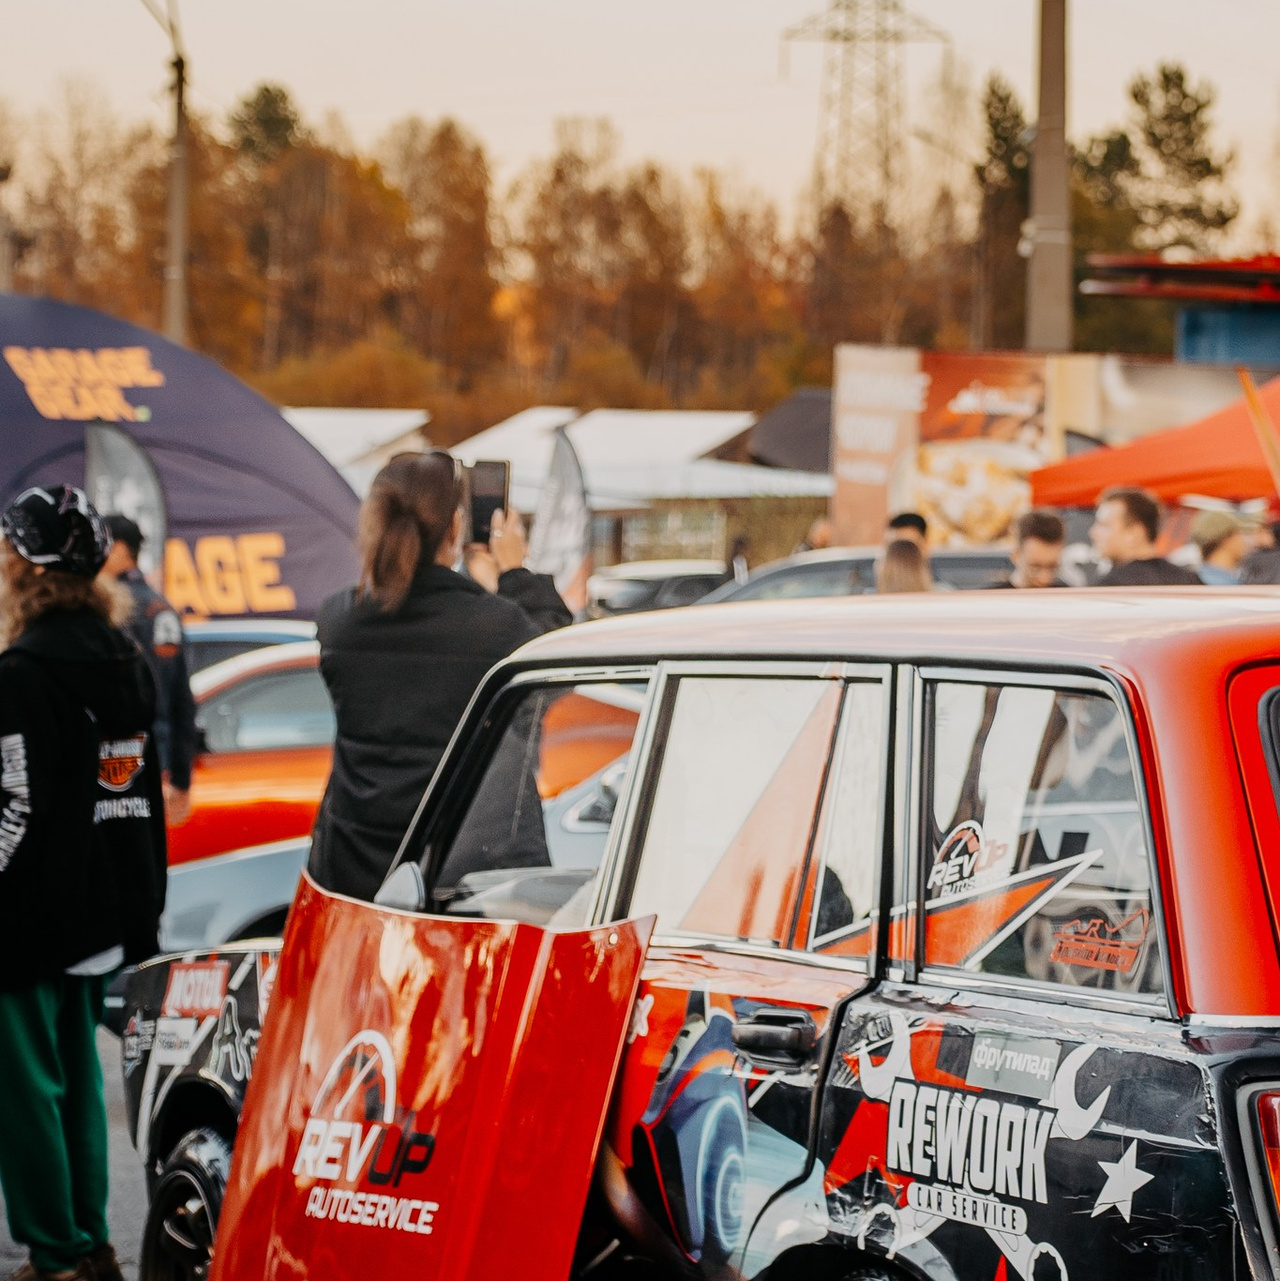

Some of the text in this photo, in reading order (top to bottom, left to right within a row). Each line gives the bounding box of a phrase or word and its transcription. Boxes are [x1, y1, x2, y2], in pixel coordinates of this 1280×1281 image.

[167, 968, 224, 1011] MOTUL
[886, 1080, 1055, 1205] REWORK
[304, 1185, 440, 1235] AUTOSERVICE
[916, 1186, 1017, 1232] CAR SERVICE
